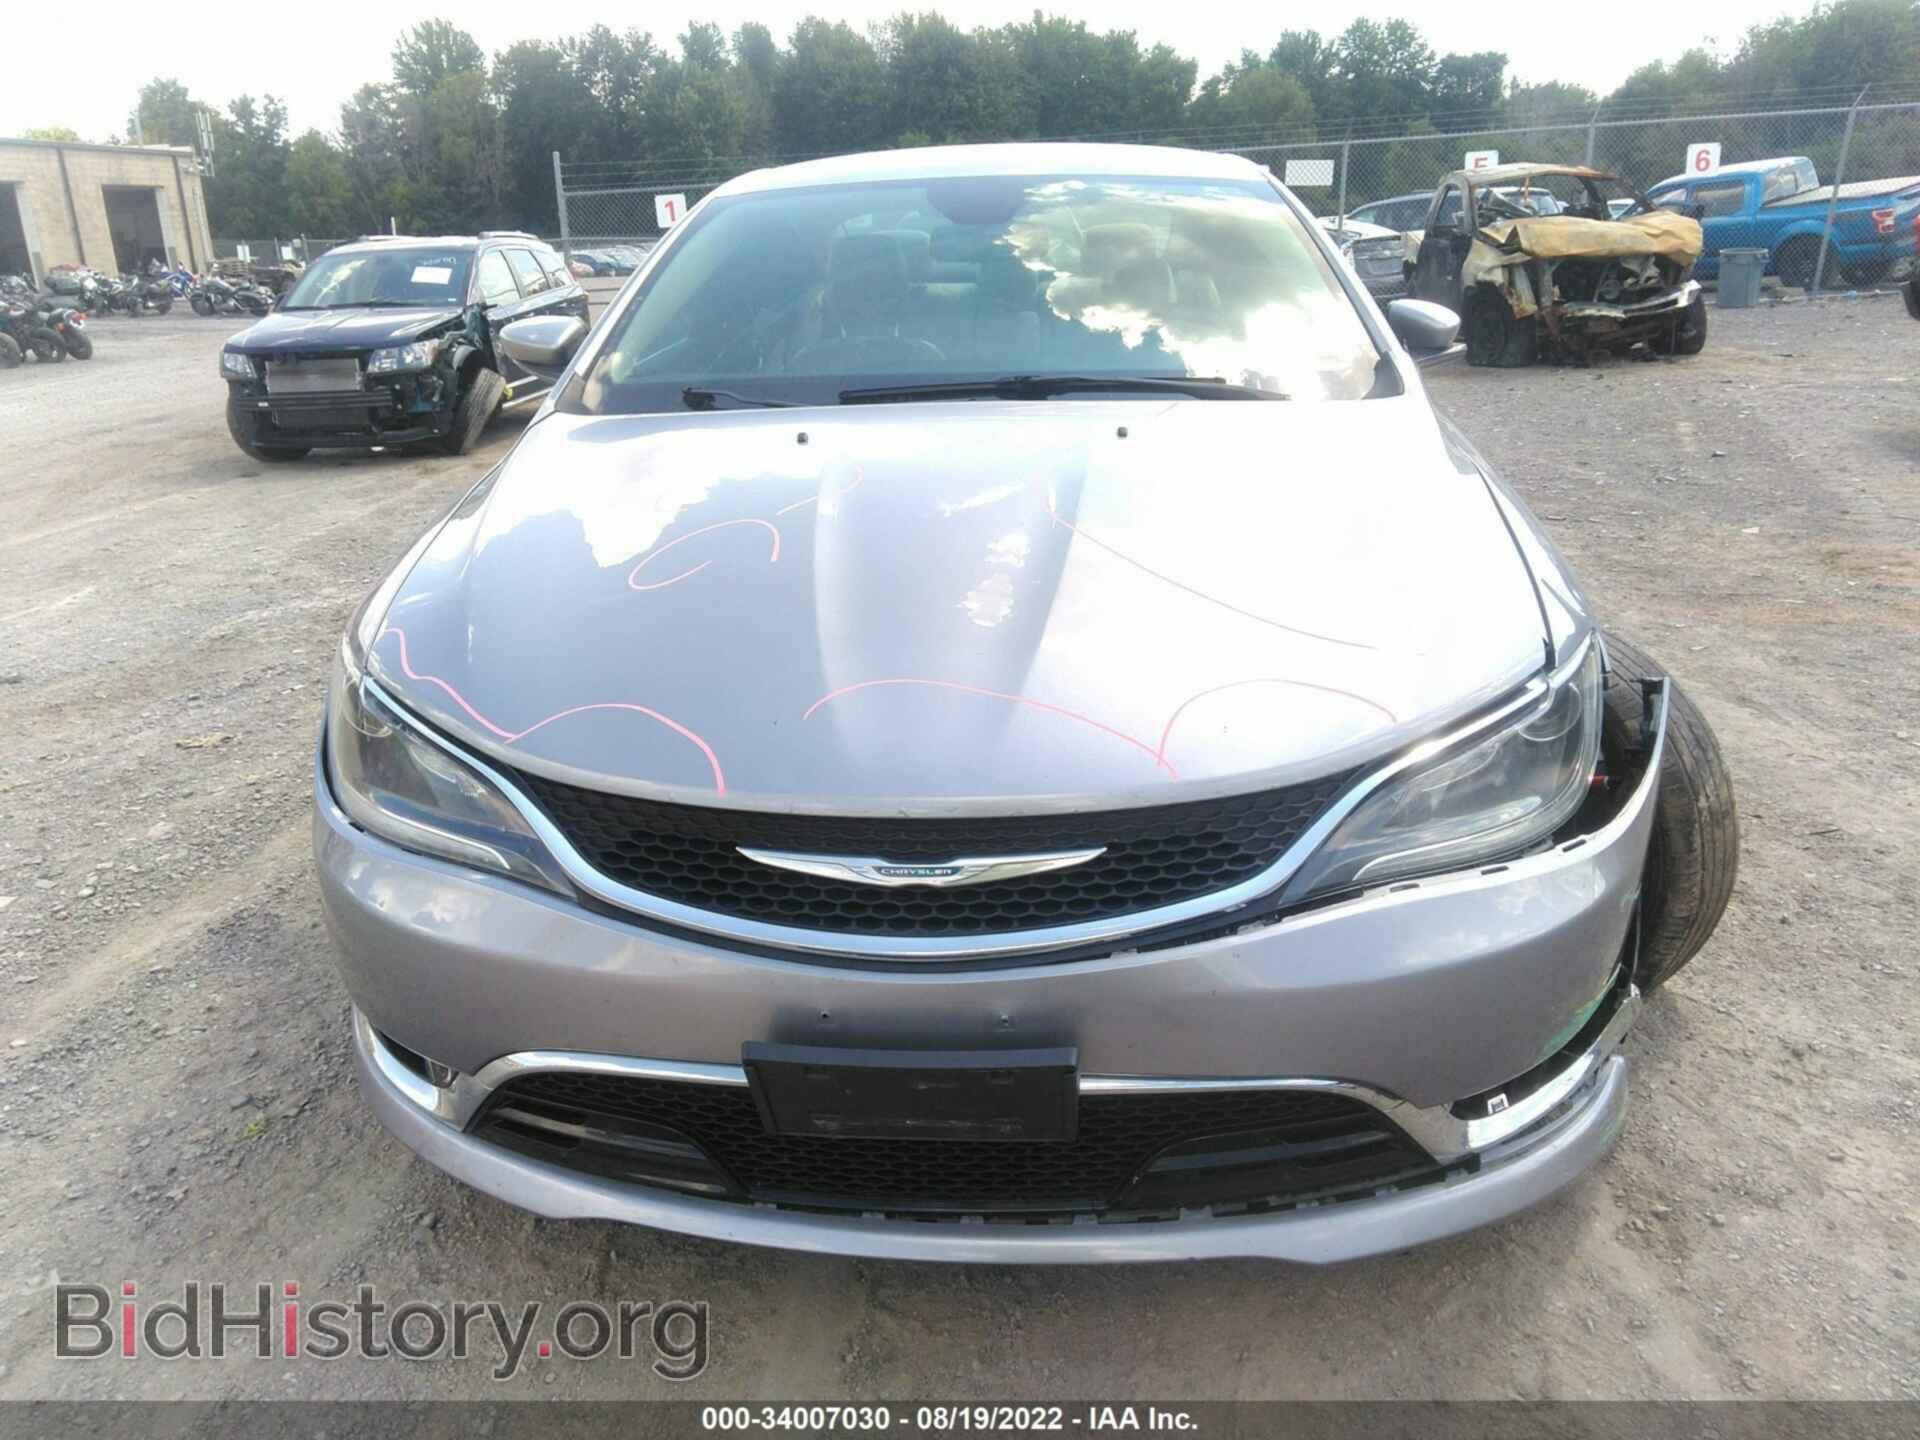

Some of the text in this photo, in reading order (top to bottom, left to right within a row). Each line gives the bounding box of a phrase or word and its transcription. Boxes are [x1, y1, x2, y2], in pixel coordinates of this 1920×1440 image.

[1695, 149, 1711, 172] 6
[664, 199, 676, 222] 1
[880, 868, 952, 876] CHRYSLER
